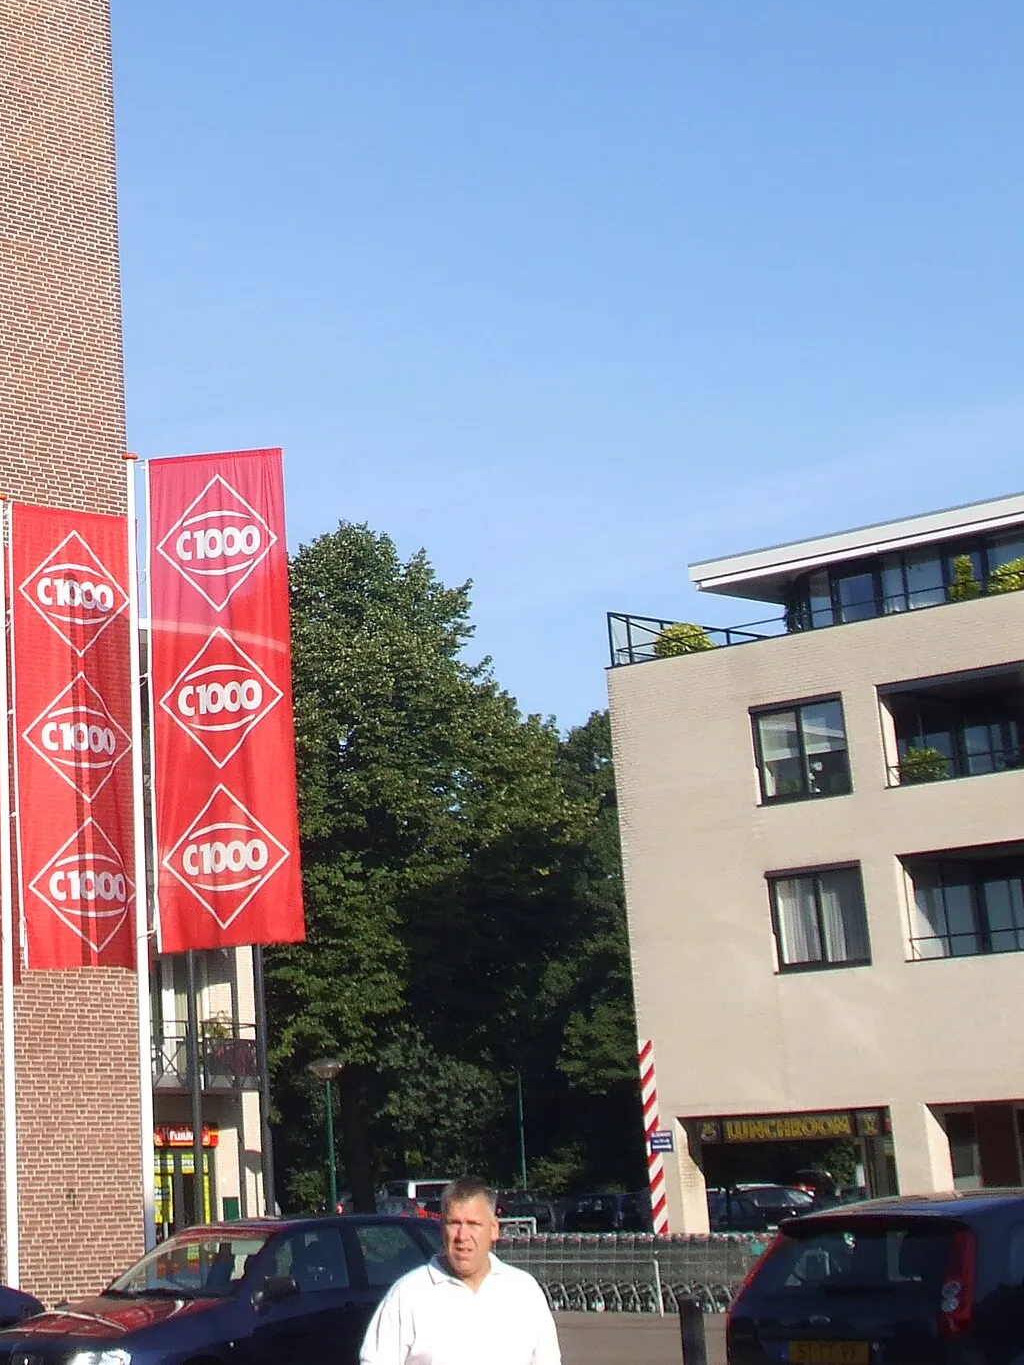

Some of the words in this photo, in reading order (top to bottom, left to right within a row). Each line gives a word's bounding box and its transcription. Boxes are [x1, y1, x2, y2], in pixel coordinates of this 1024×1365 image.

[176, 525, 261, 561] C1000
[37, 577, 114, 612] C1000
[178, 679, 262, 717] C1000
[41, 721, 116, 755] C1000
[182, 839, 268, 875] C1000
[49, 870, 126, 902] C1000
[728, 1115, 851, 1139] LUNCHROOM
